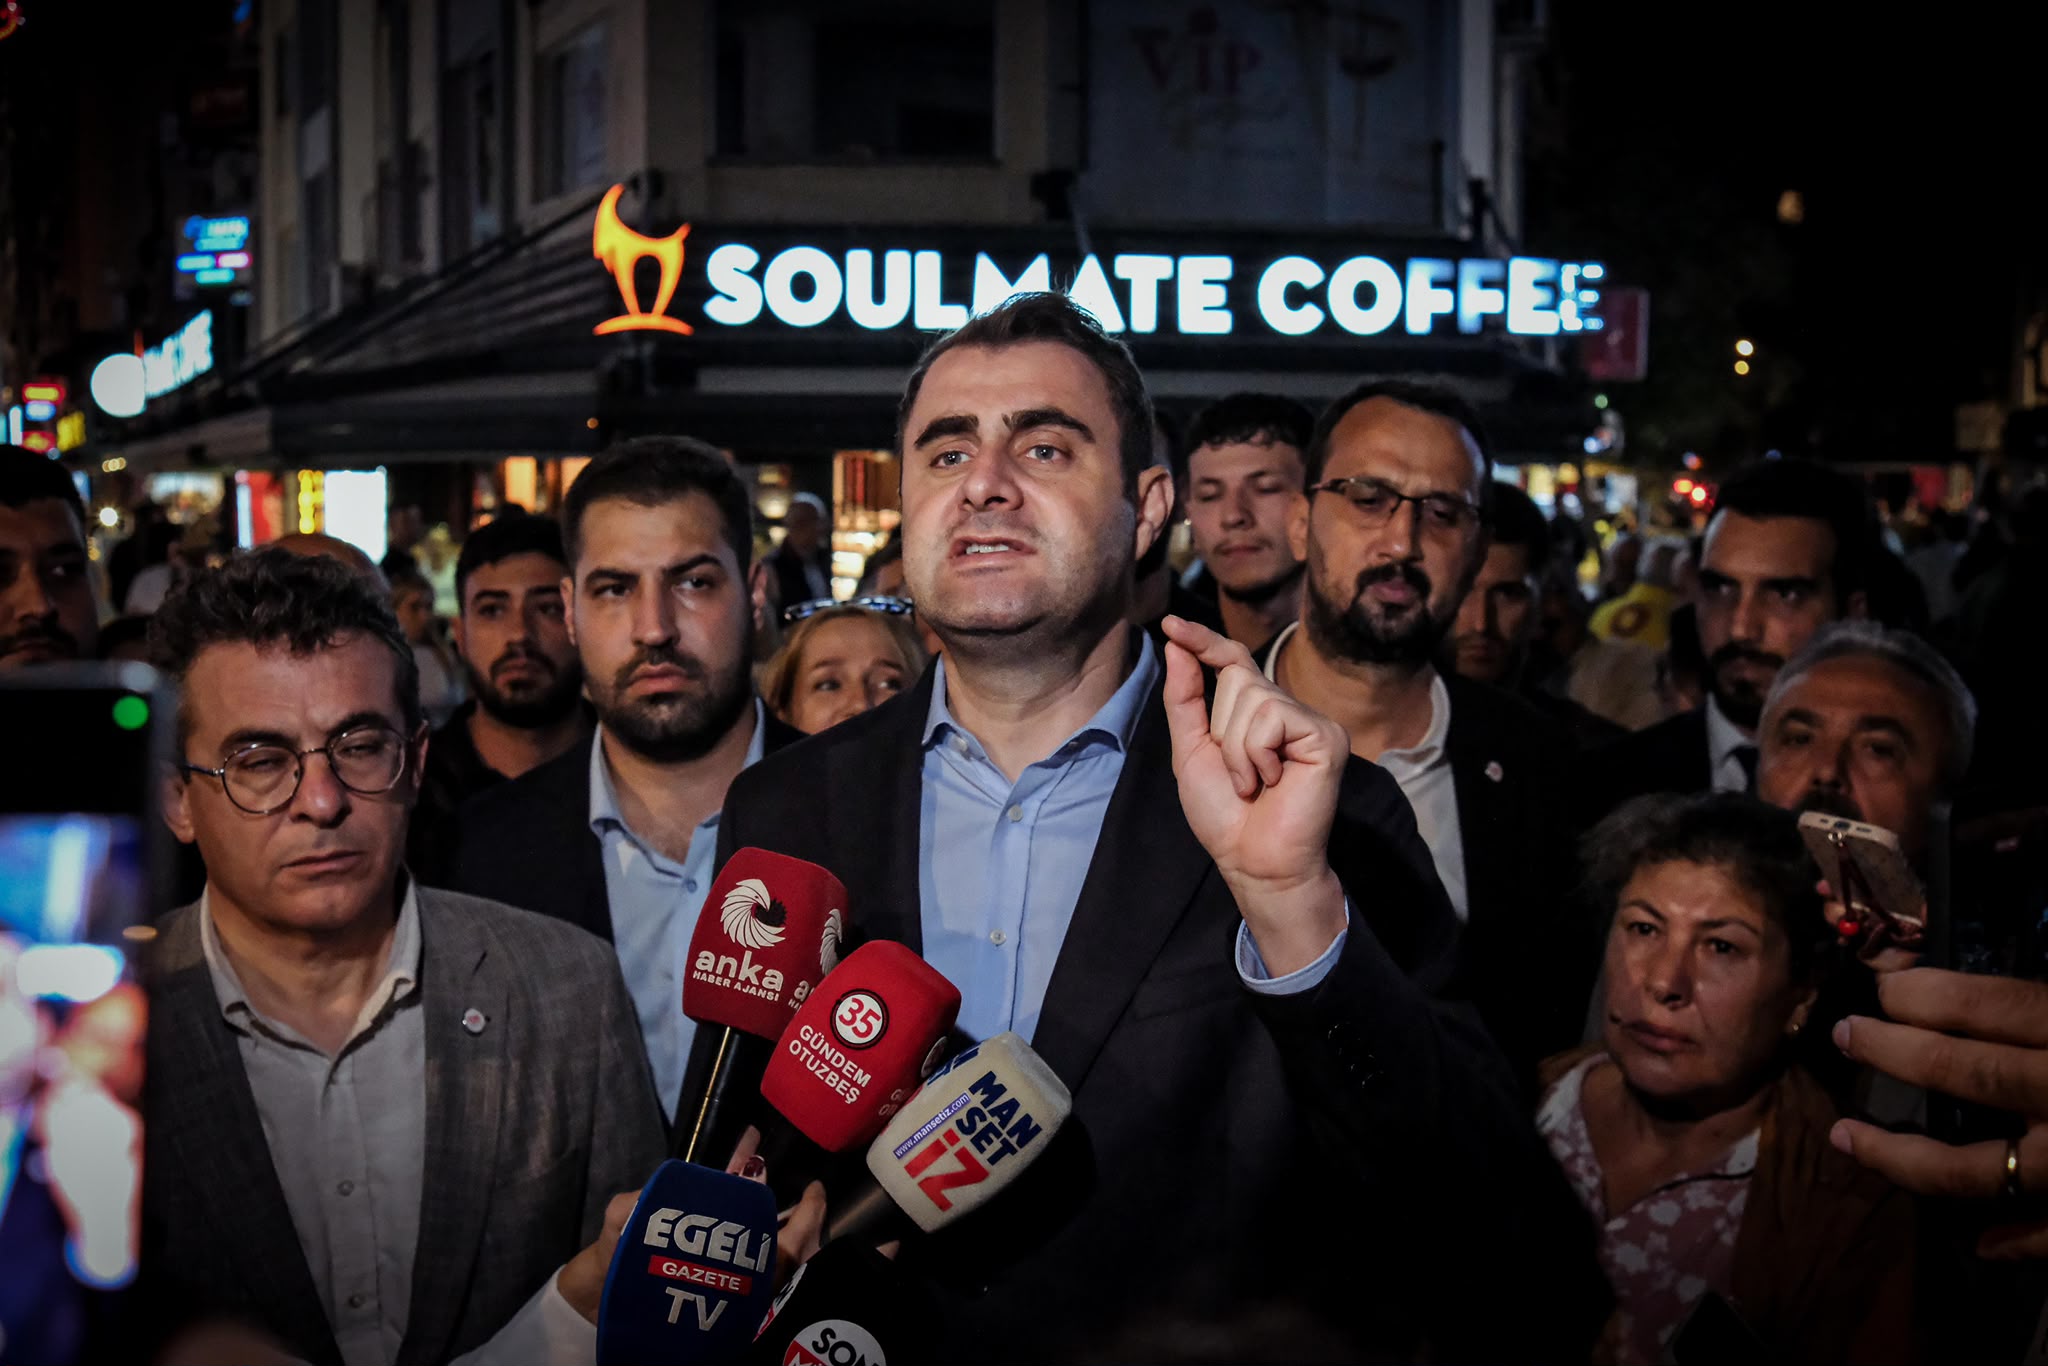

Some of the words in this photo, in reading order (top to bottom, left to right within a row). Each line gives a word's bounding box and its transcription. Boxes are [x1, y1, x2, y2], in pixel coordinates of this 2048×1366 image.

[703, 243, 1233, 334] SOULMATE
[1257, 256, 1604, 335] COFFEE
[692, 970, 731, 988] HABER
[733, 982, 780, 1002] AJANSI
[695, 950, 784, 991] anka
[838, 997, 882, 1039] 35
[789, 1039, 861, 1105] OTUZBEŞ
[800, 1025, 872, 1088] GÜNDEM
[894, 1093, 970, 1158] www.mansetiz.com
[956, 1107, 1019, 1166] SET
[968, 1070, 1043, 1149] MAN
[662, 1262, 741, 1290] GAZETE
[665, 1286, 728, 1331] TV
